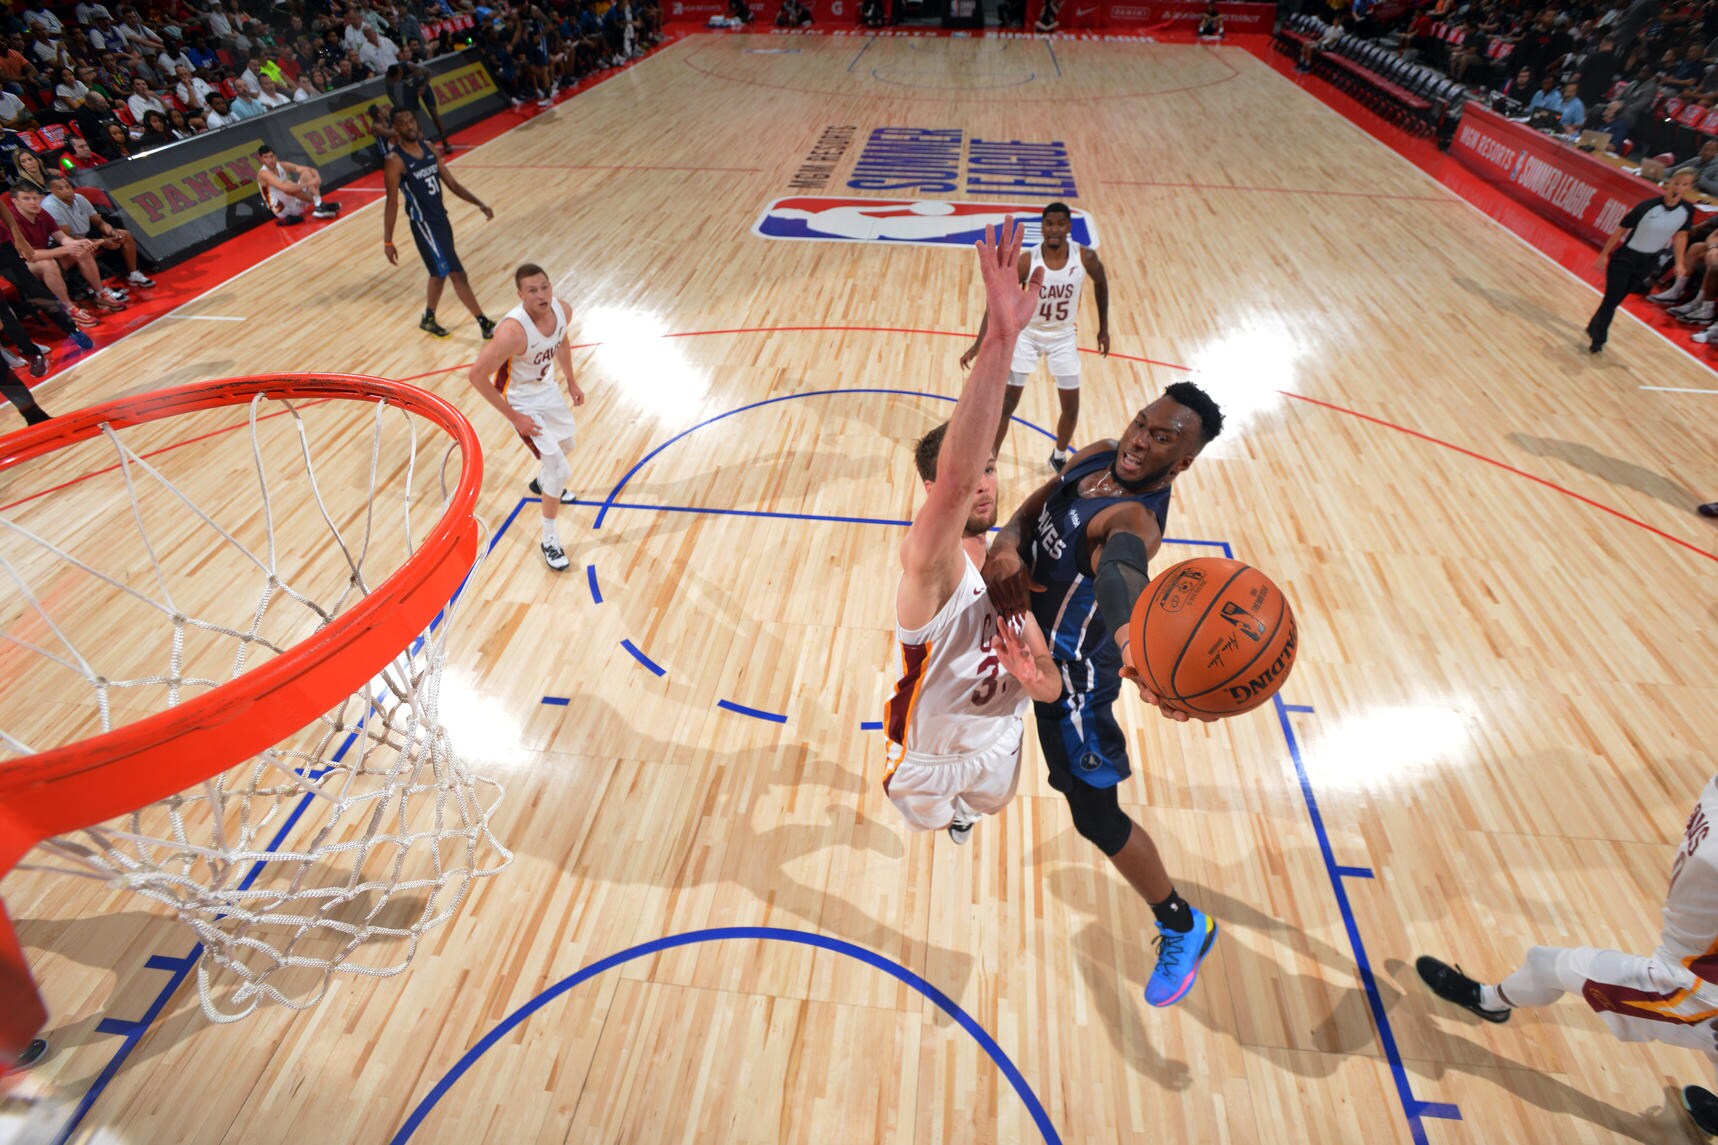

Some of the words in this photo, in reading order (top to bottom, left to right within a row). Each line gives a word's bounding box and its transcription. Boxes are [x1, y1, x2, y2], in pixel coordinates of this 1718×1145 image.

[432, 70, 490, 107] ANINI
[303, 104, 392, 156] PANI
[846, 127, 963, 193] SUMMER
[965, 138, 1079, 198] LEAGUE
[1476, 137, 1515, 170] RESORTS
[424, 175, 440, 196] 31
[1038, 283, 1074, 300] CAVS
[1038, 300, 1070, 321] 45
[1228, 617, 1298, 705] ALDING
